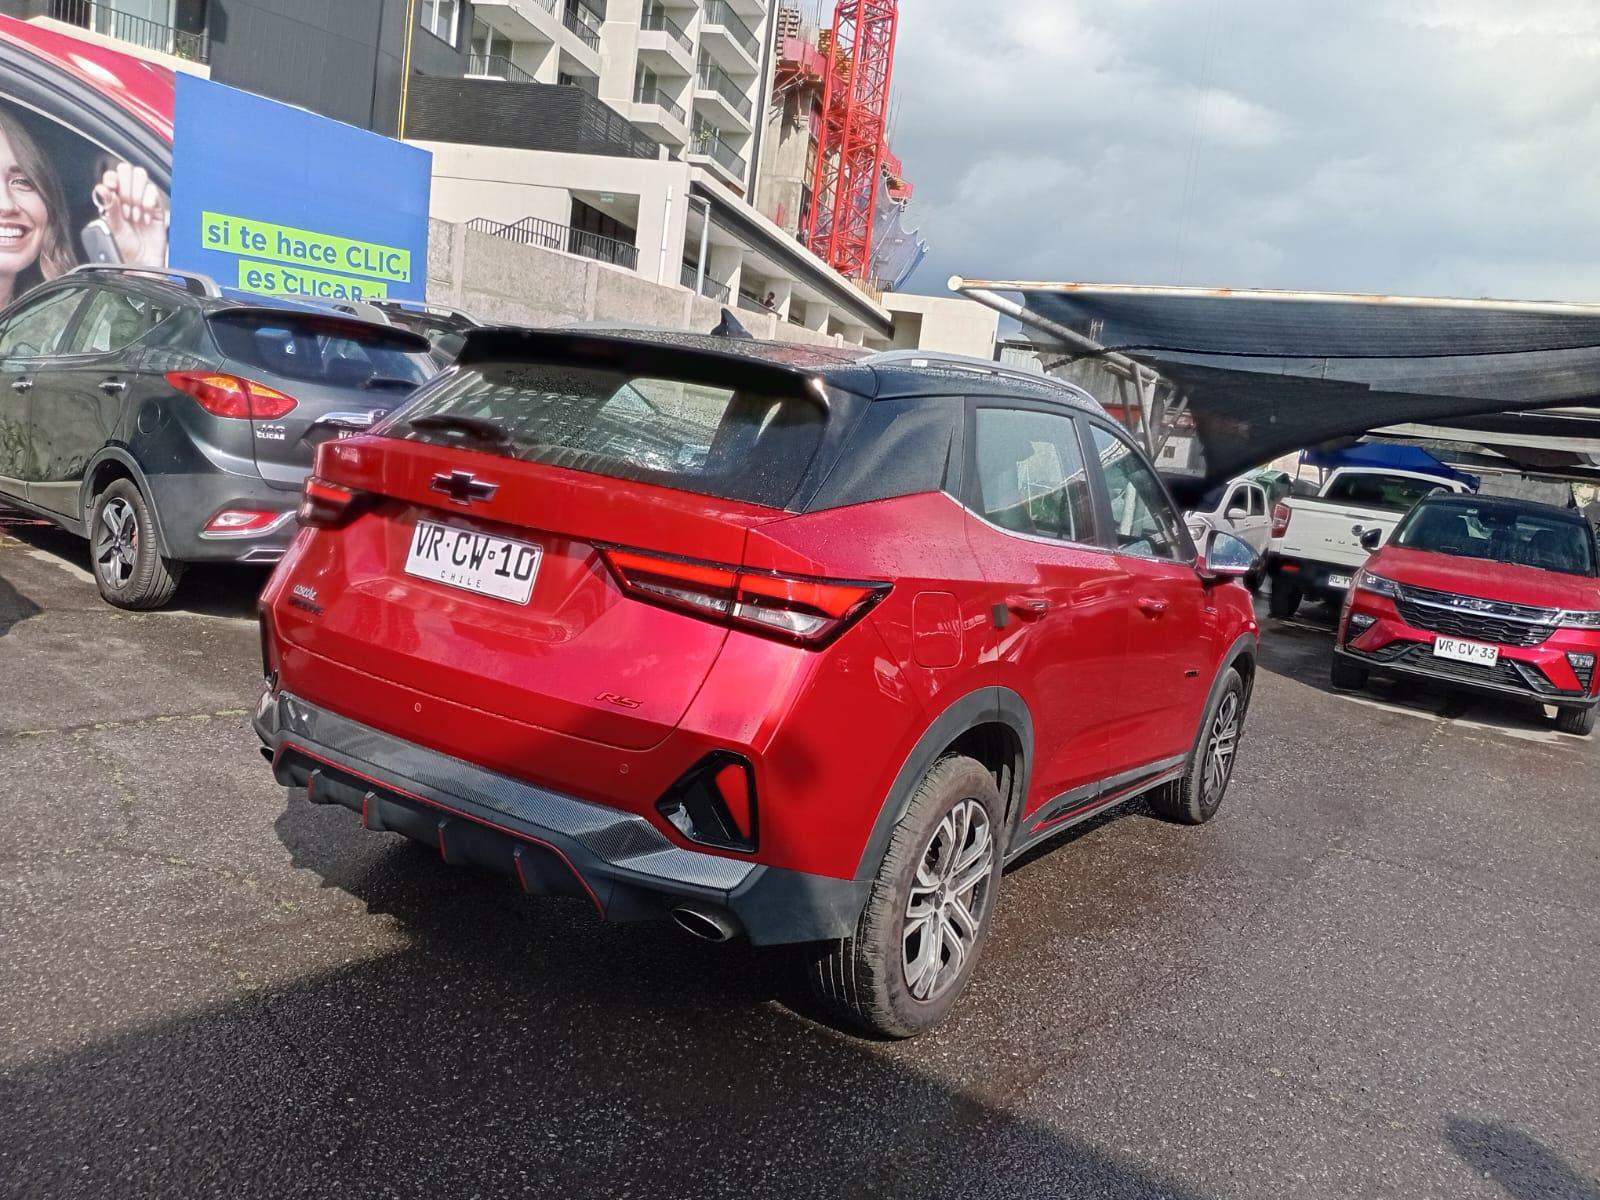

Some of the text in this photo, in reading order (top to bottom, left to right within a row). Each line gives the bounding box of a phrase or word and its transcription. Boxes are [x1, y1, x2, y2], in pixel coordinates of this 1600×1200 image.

[208, 221, 408, 280] si te hace CLIC,
[247, 270, 276, 290] es
[440, 570, 483, 588] CHILE
[594, 692, 644, 709] RS
